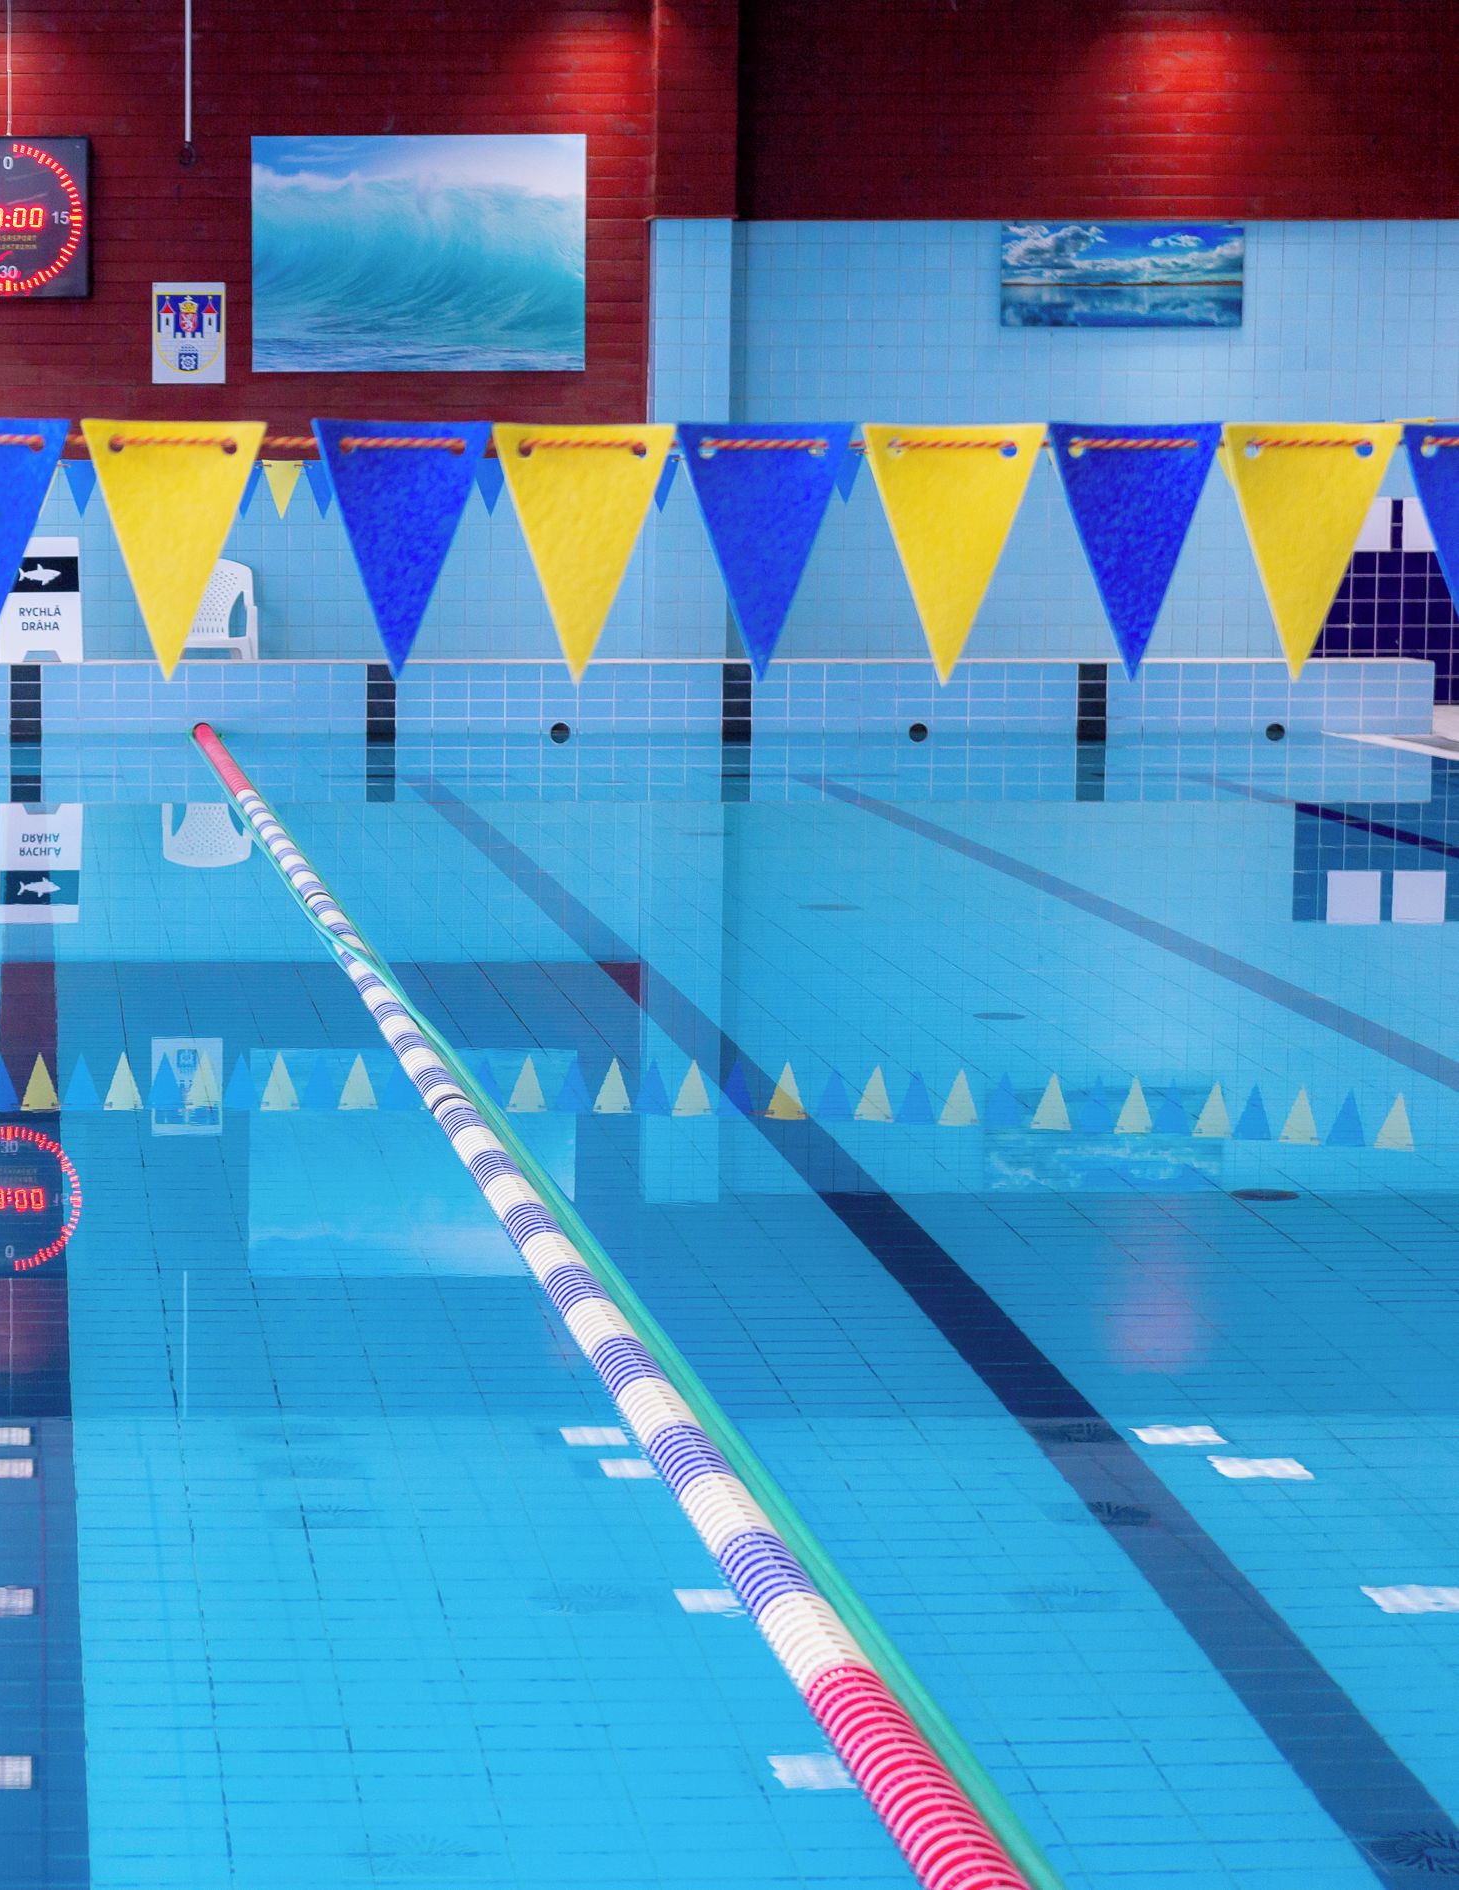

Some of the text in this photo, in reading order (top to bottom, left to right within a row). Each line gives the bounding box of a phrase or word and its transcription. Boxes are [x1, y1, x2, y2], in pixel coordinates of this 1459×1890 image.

[2, 156, 14, 170] 0
[51, 211, 70, 225] 15
[19, 604, 61, 617] RYCHLÁ
[21, 619, 60, 631] DRÁHA
